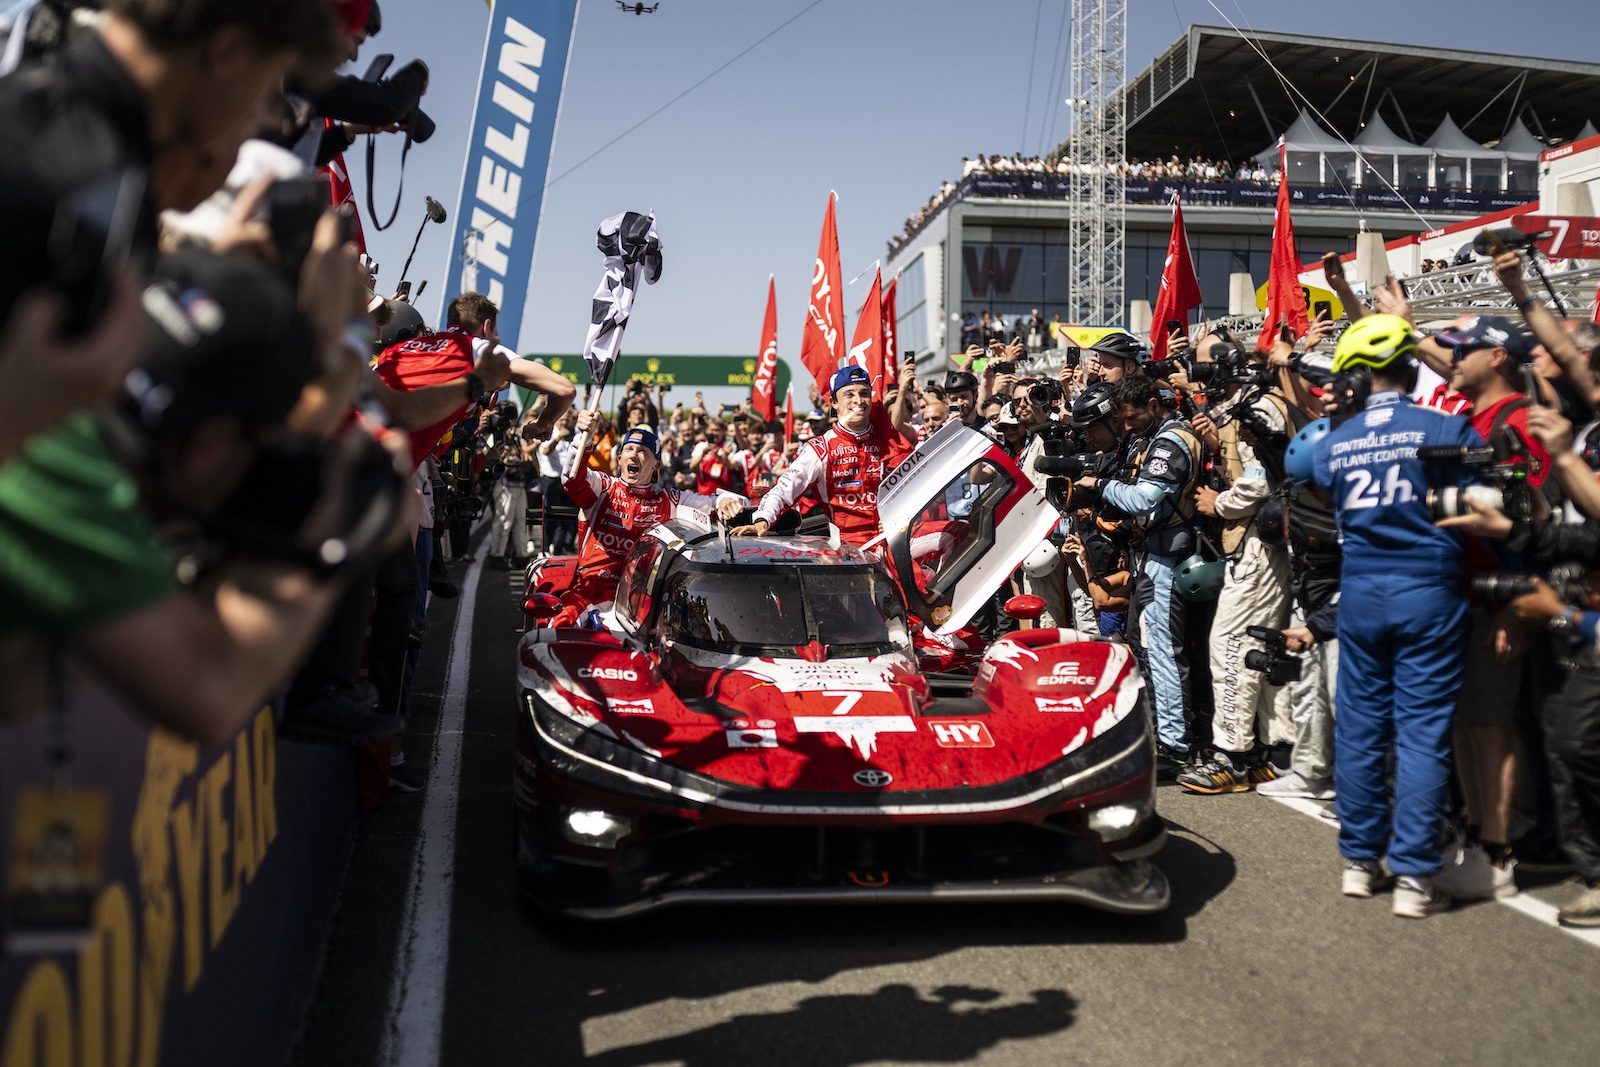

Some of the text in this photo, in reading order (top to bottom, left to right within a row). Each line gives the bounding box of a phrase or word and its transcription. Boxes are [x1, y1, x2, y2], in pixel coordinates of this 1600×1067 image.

[1548, 219, 1600, 255] 7 TO
[632, 373, 676, 384] ROLEX
[831, 443, 858, 457] FUJITSU
[1333, 431, 1426, 455] CONTRÔLE PISTE
[1343, 452, 1373, 467] LANE
[832, 469, 854, 478] Mobil
[881, 450, 925, 491] TOYOTA
[1254, 468, 1264, 476] TV
[640, 505, 658, 513] ZENT
[693, 509, 708, 525] TOYOTA
[737, 547, 842, 558] DENSO
[577, 667, 638, 682] CASIO
[1037, 675, 1096, 686] EDIFICE
[1223, 632, 1242, 745] HOST BROADCASTER
[821, 690, 864, 715] 7
[1038, 705, 1085, 713] MARELLI
[934, 724, 982, 743] HY
